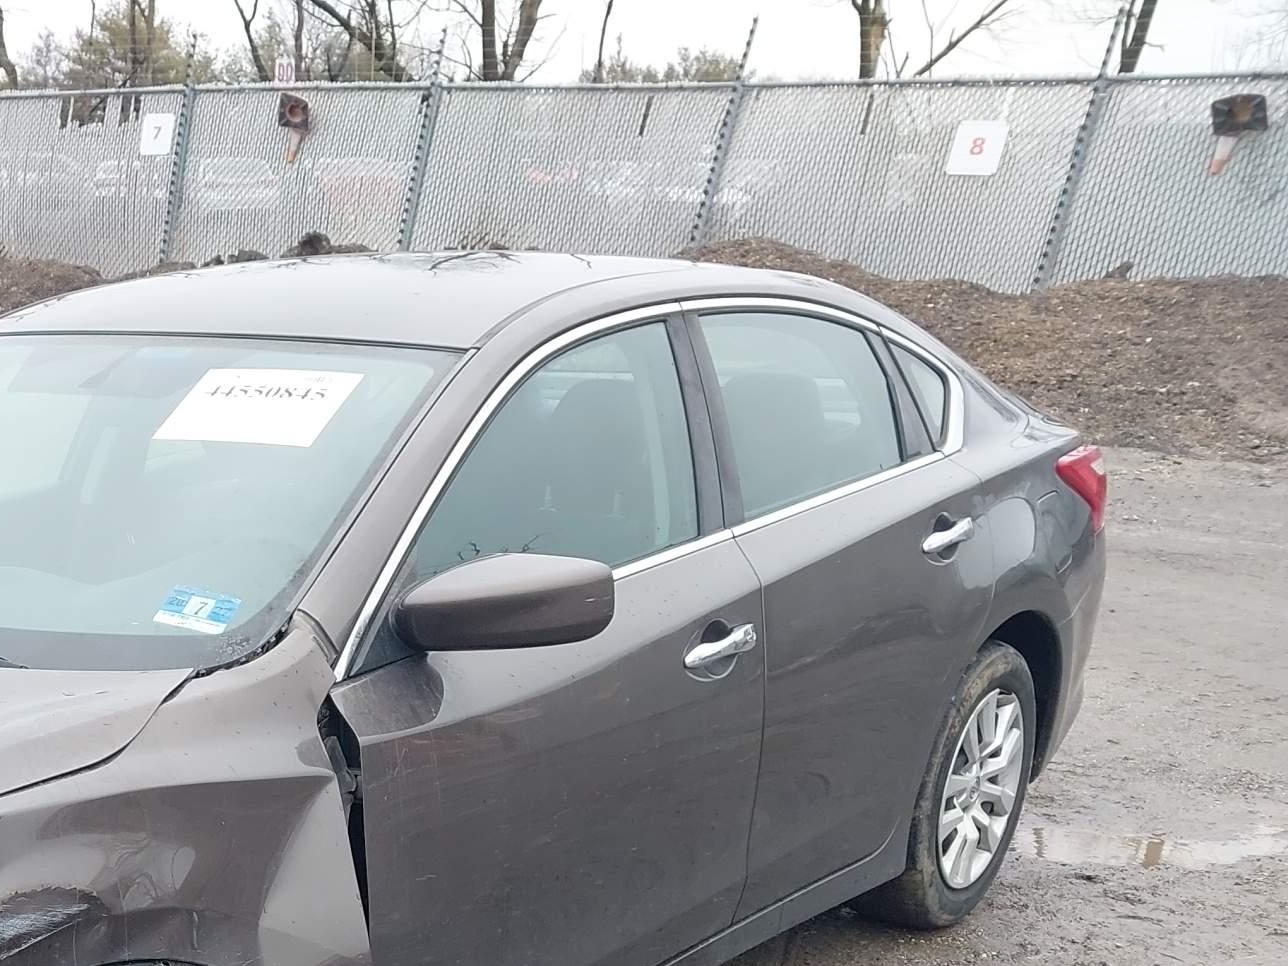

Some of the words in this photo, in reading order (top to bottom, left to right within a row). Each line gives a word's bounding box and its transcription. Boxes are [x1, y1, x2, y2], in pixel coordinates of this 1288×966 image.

[153, 125, 162, 140] 7
[969, 137, 986, 155] 8
[194, 601, 209, 615] 7
